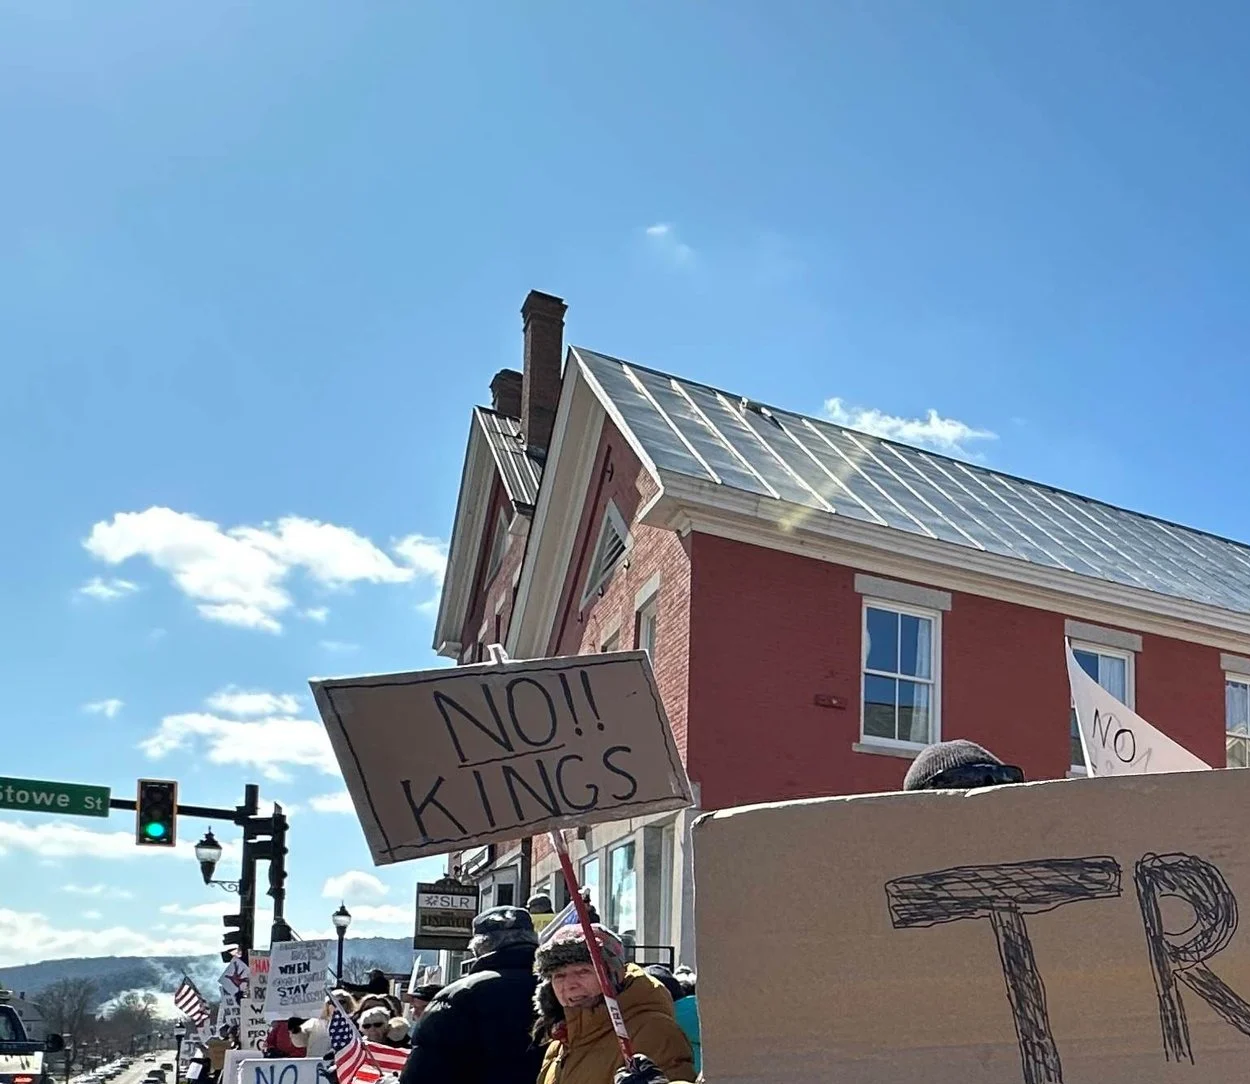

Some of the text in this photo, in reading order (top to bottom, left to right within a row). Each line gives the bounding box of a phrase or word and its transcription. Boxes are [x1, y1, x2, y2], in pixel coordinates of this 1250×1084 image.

[433, 669, 606, 763] NO!!
[1092, 708, 1136, 763] NO
[0, 785, 102, 810] towe St
[400, 745, 638, 839] KINGS
[440, 896, 469, 908] SLR
[278, 960, 310, 975] WHEN
[277, 983, 309, 998] STAY
